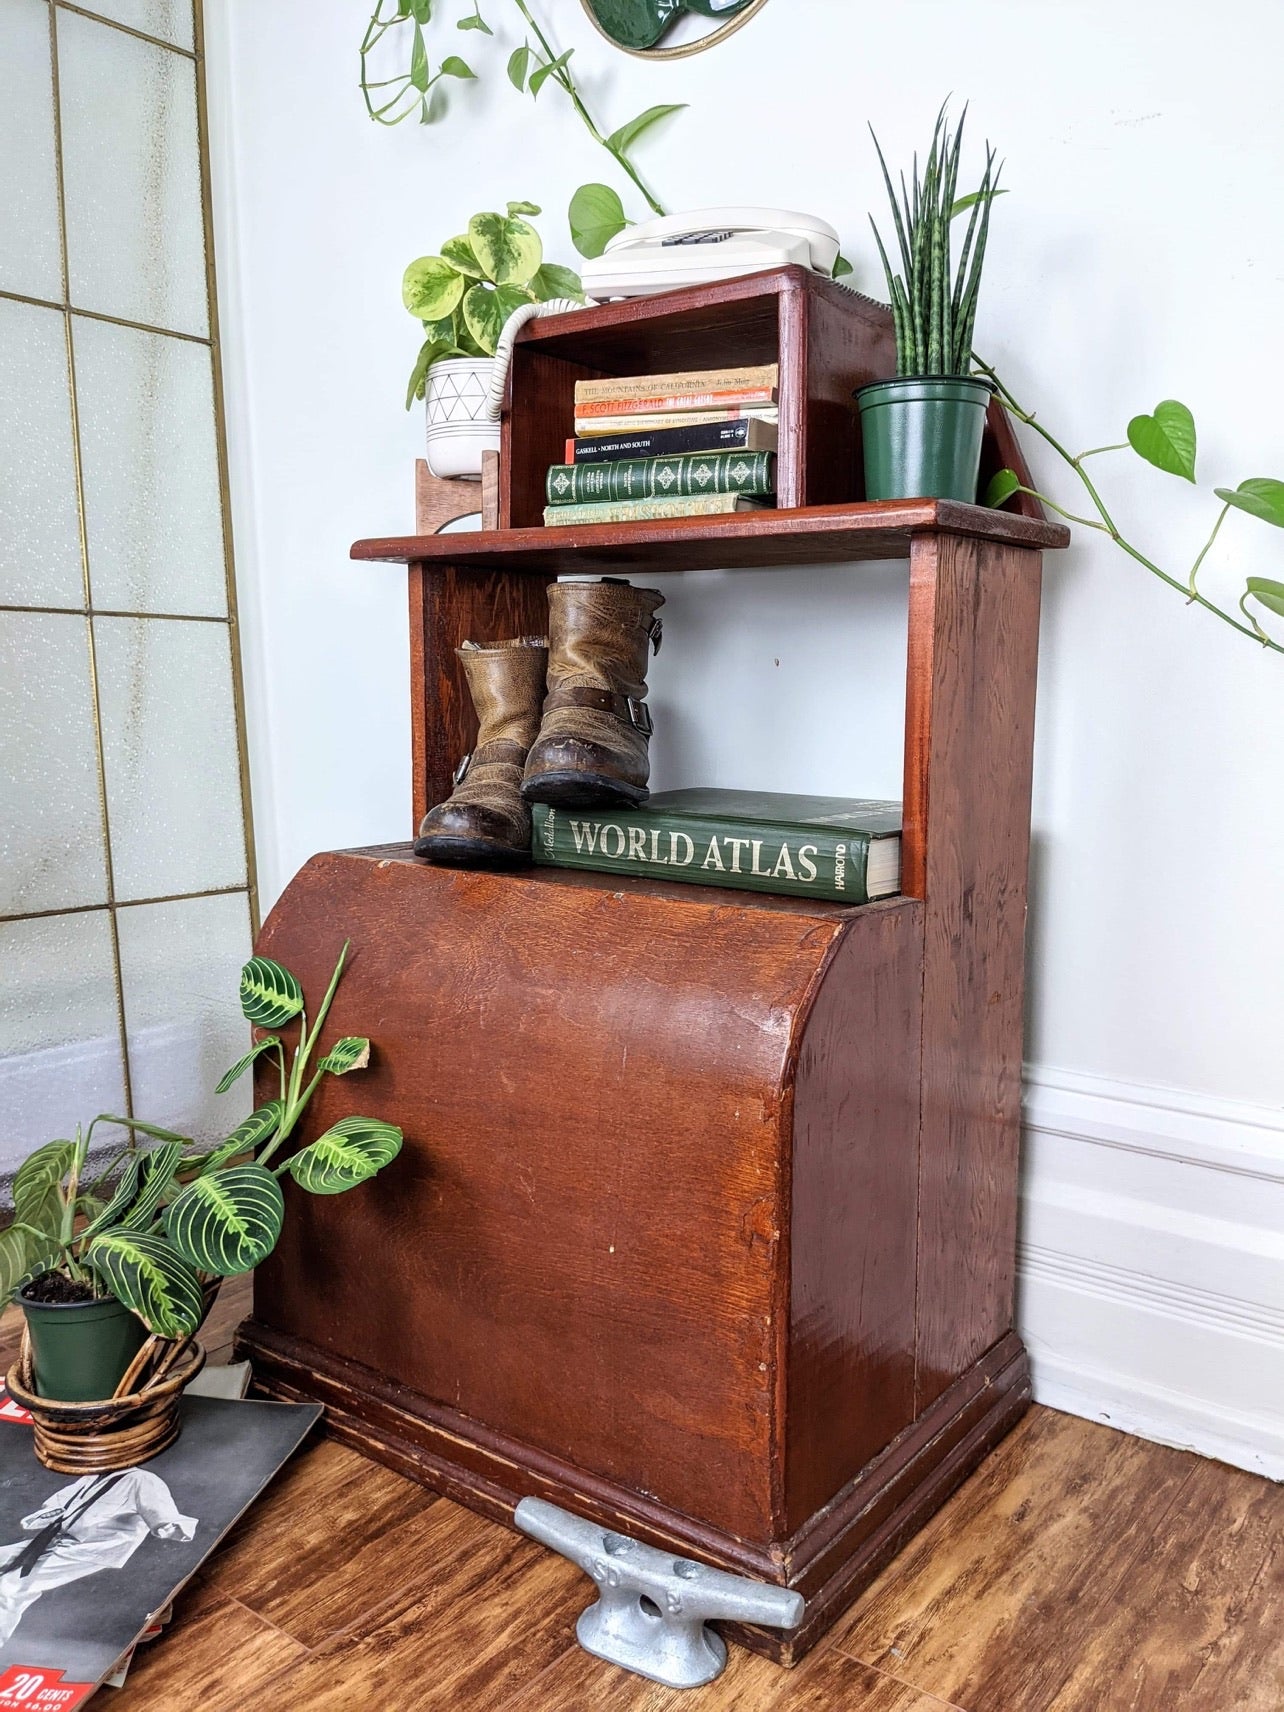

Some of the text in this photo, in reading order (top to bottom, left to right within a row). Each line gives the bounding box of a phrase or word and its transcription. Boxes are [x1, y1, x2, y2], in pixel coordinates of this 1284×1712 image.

[584, 387, 597, 396] THE
[601, 385, 646, 394] MOUNTAINS
[647, 384, 657, 392] OF
[660, 381, 706, 391] CALIFORNIA
[590, 403, 615, 414] SCOTT
[617, 398, 664, 411] FITZGERALD
[575, 440, 651, 455] GASKELL NORTH AND SOUTH
[543, 807, 556, 859] Medallion
[569, 820, 818, 882] WORLD ATLAS
[0, 1673, 74, 1702] 20 CENTS
[25, 1701, 62, 1711] $6.00
